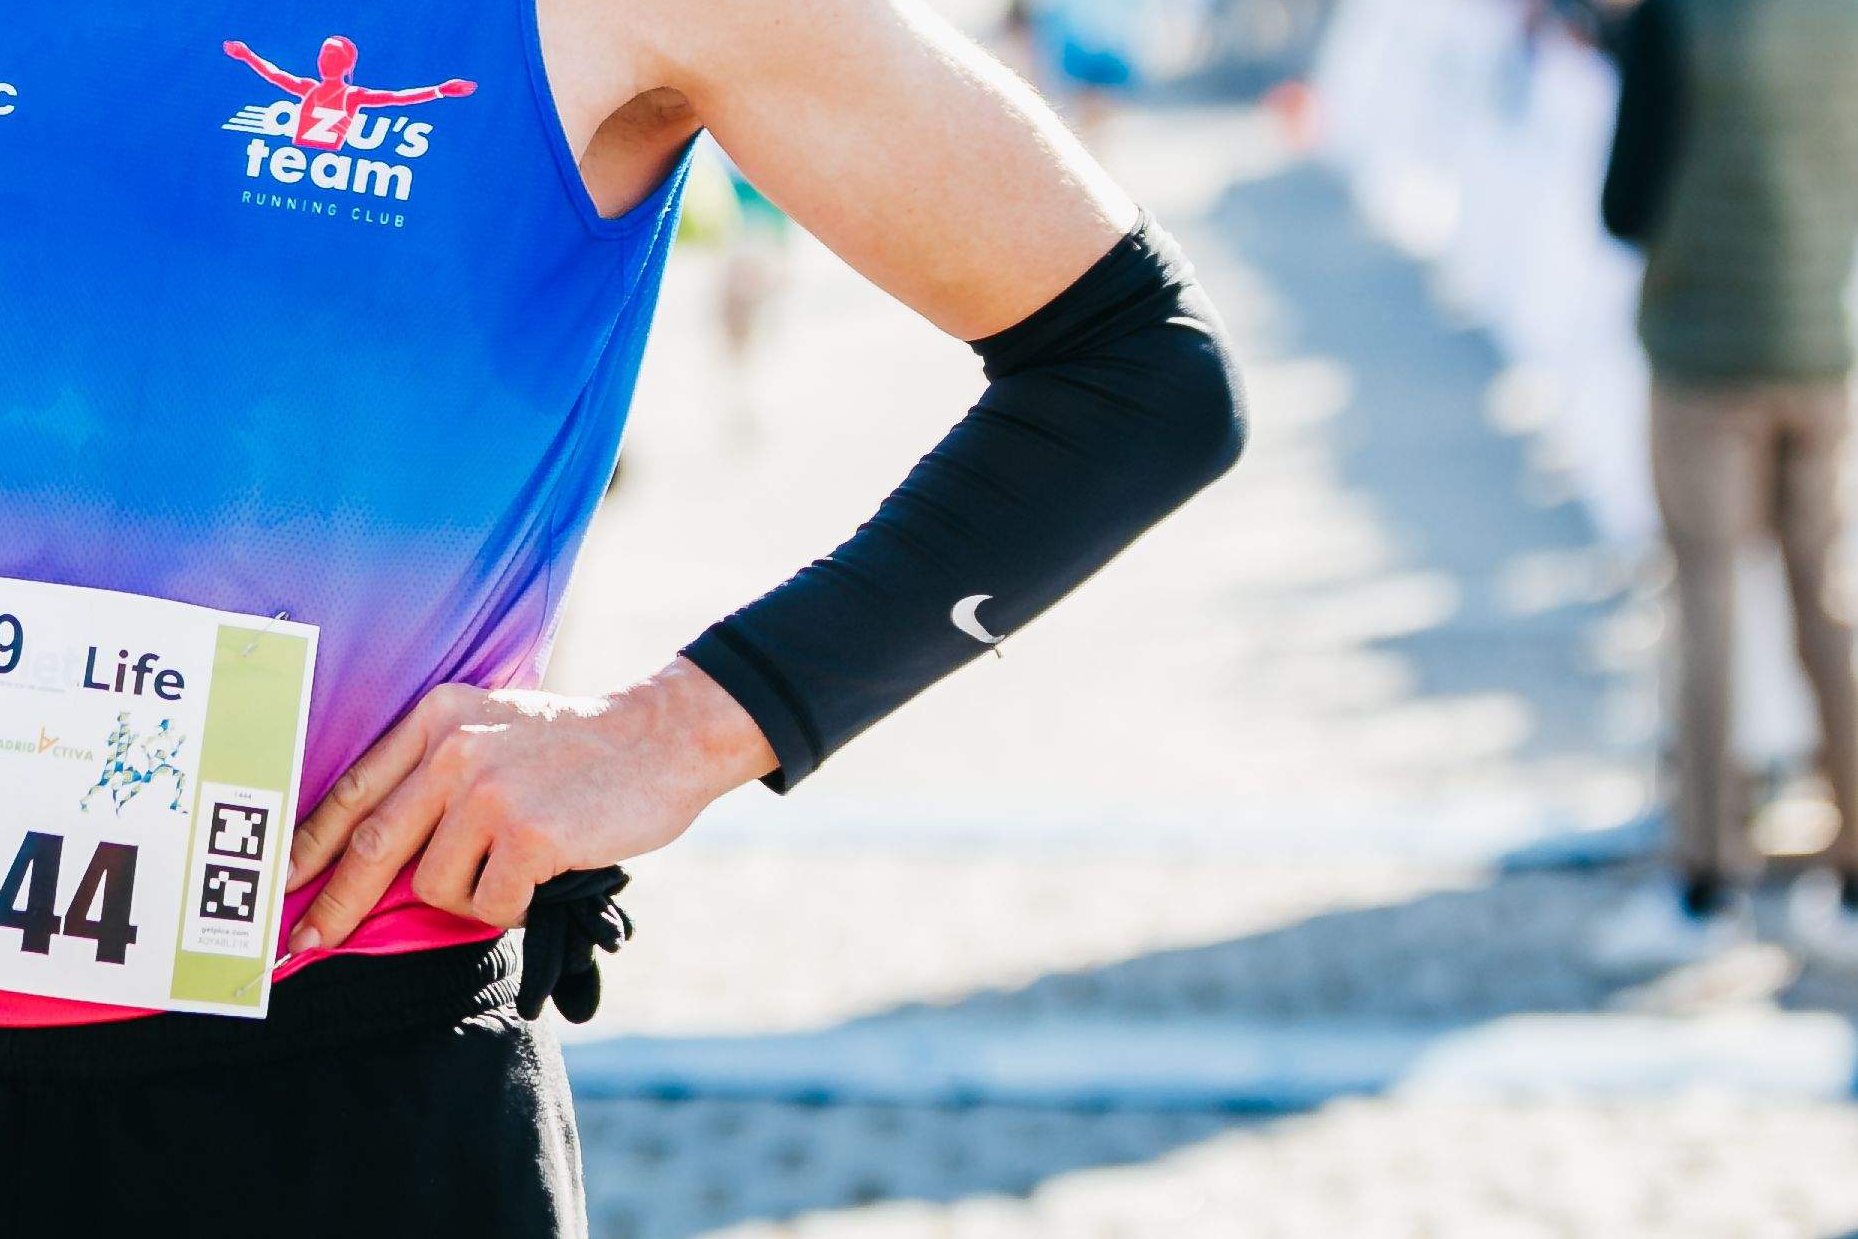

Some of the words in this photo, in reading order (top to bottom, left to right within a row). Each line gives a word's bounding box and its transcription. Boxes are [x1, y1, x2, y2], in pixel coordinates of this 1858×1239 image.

[246, 138, 414, 201] team
[241, 190, 338, 217] RUNNING
[350, 206, 406, 229] CLUB
